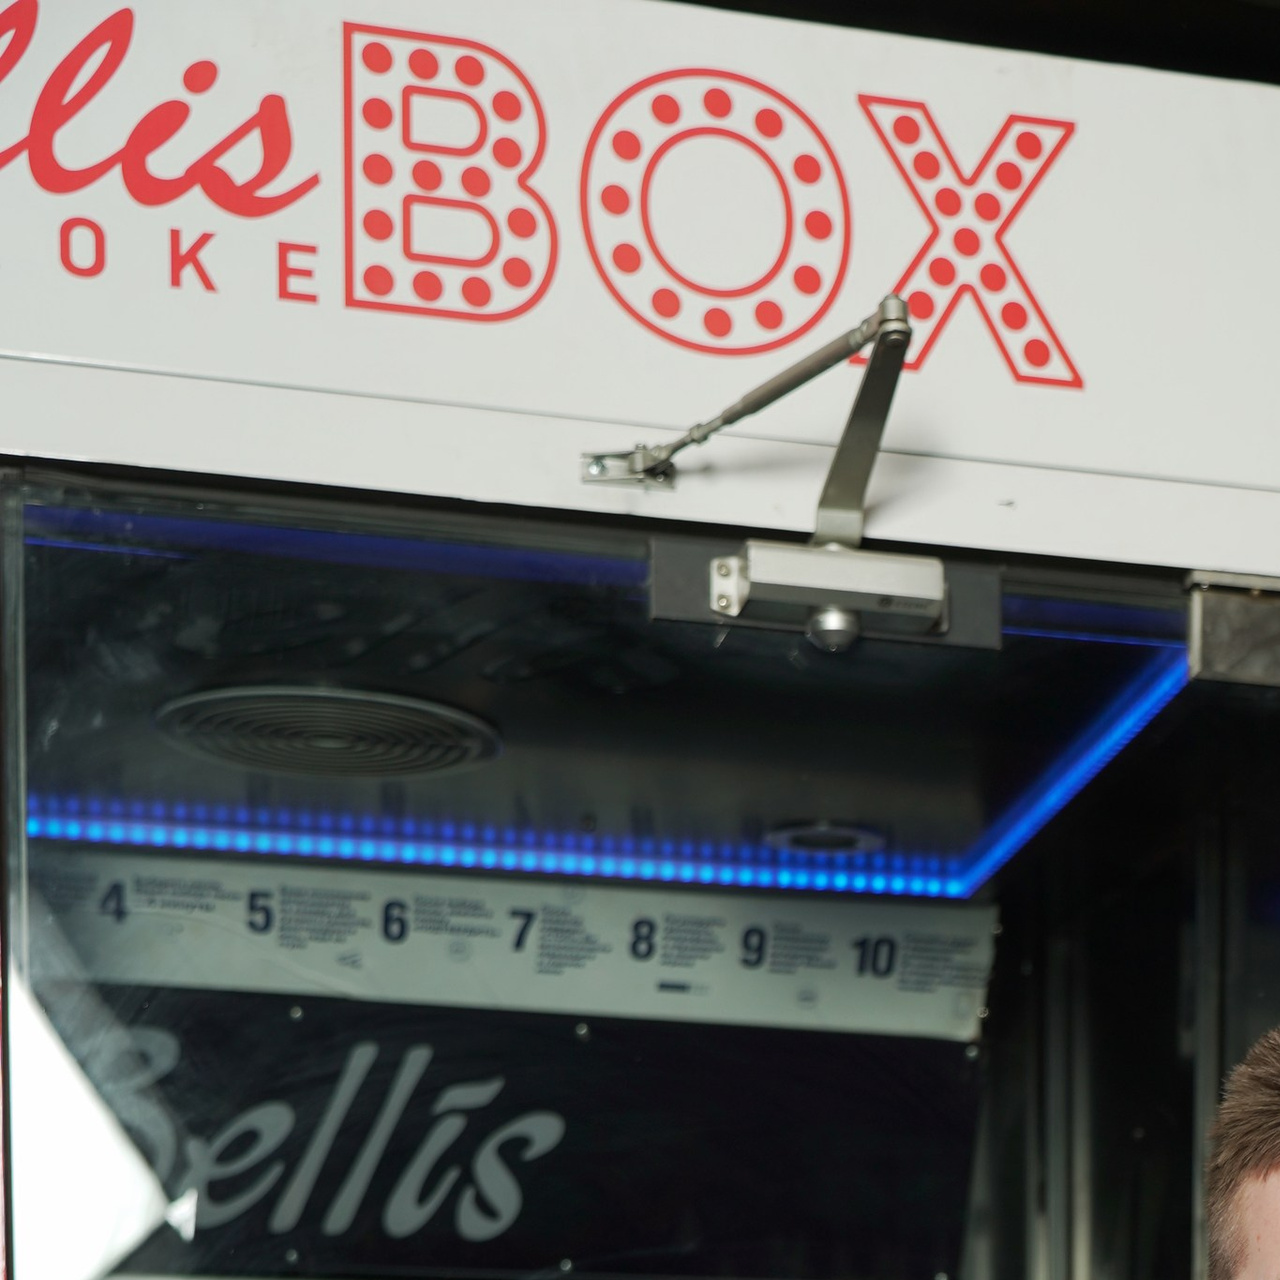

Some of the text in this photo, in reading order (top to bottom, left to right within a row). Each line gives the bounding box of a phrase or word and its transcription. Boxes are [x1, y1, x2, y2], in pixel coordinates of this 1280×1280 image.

[342, 21, 1084, 388] BOX
[98, 881, 130, 924] 4
[245, 889, 276, 934] 5
[380, 898, 412, 944] 6
[508, 907, 537, 952] 7
[630, 917, 660, 962] 8
[740, 925, 767, 969] 9
[852, 933, 898, 979] 10
